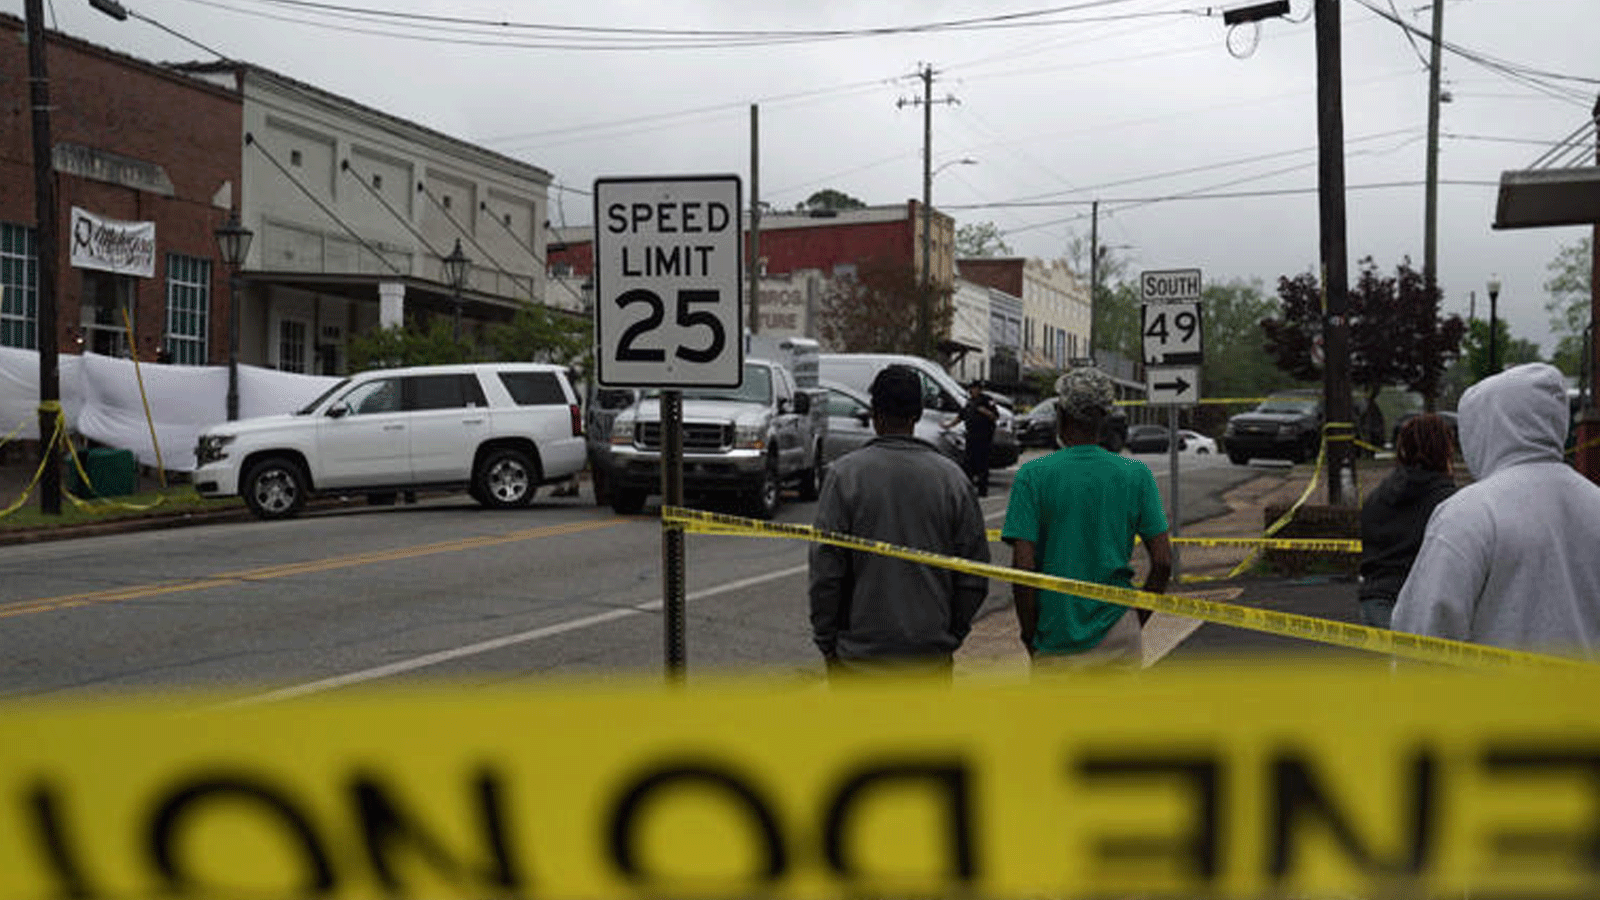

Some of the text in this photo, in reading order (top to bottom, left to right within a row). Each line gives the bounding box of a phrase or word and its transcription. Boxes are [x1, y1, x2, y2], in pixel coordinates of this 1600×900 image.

[607, 202, 730, 234] SPEED
[621, 246, 715, 277] LIMIT
[1145, 276, 1198, 296] SOUTH
[614, 288, 726, 364] 25
[1145, 311, 1197, 345] 49
